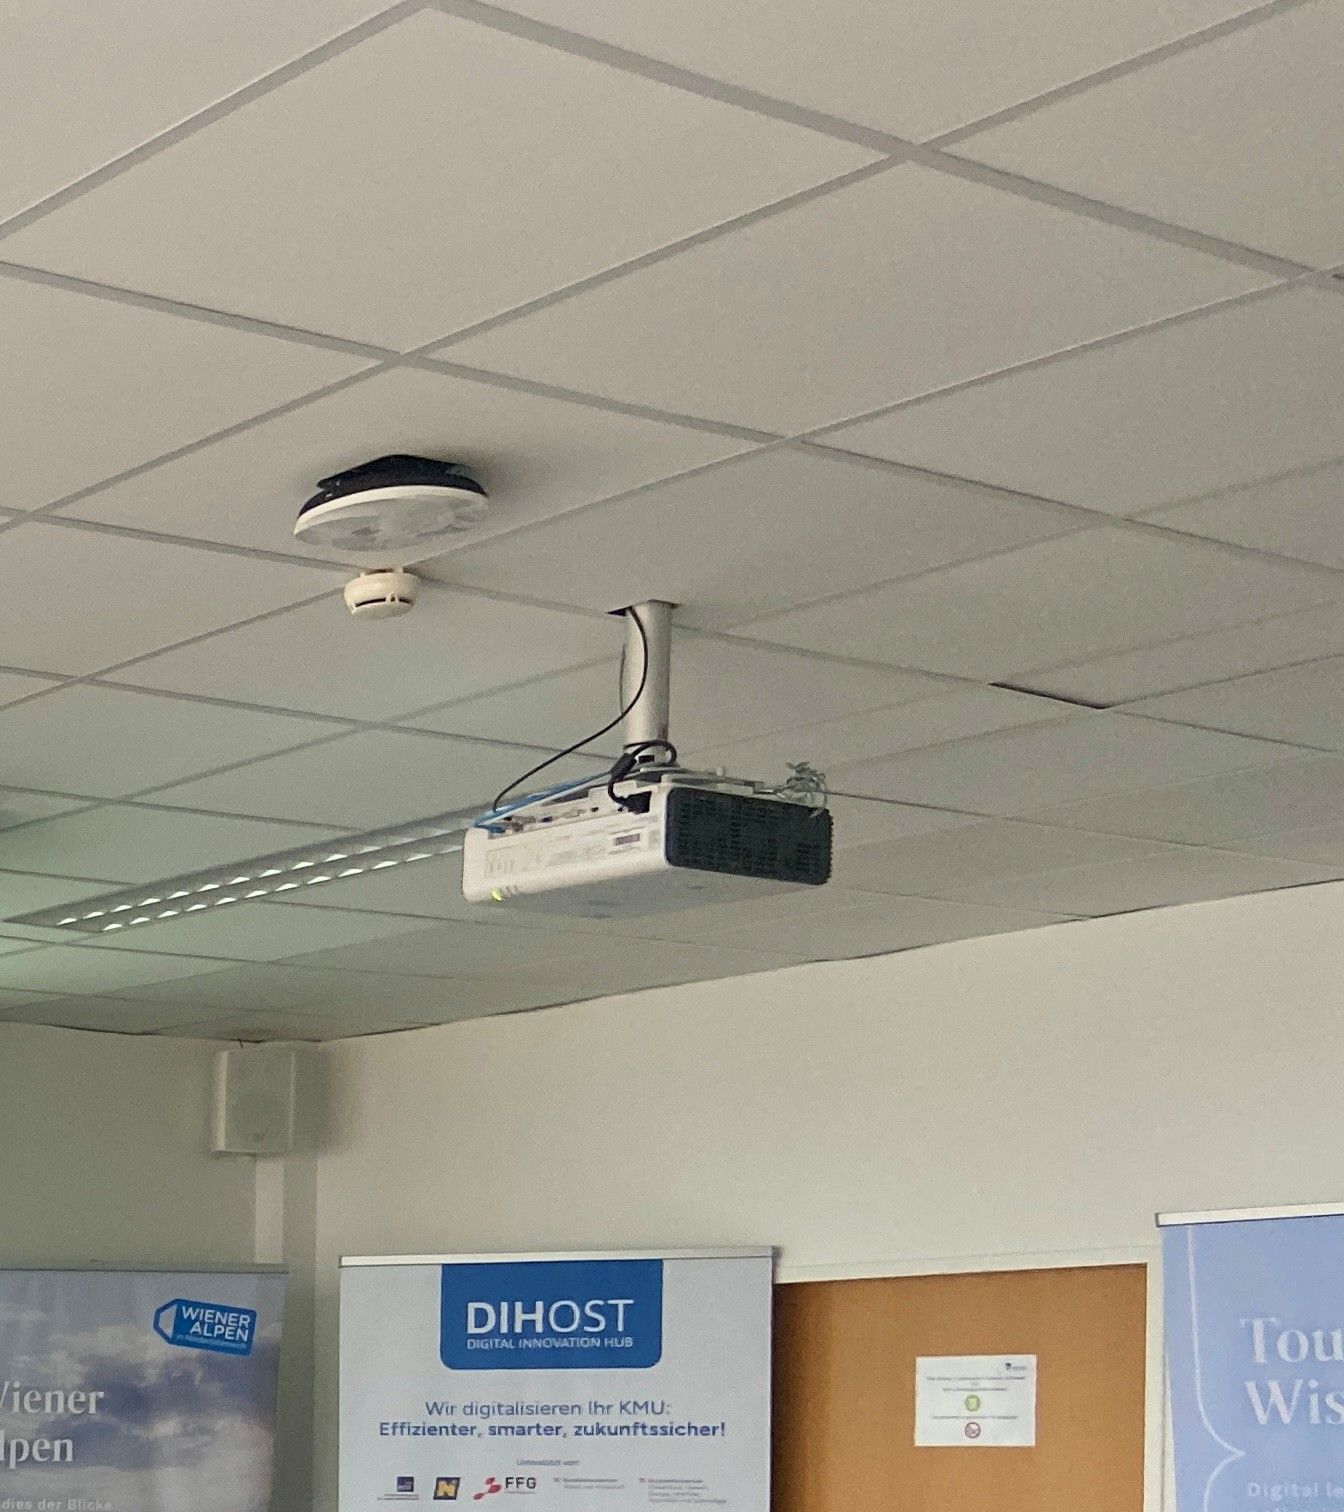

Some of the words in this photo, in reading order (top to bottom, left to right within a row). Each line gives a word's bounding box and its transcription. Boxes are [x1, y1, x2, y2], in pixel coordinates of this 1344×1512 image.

[182, 1305, 251, 1330] WIENER
[466, 1299, 634, 1335] DIHOST
[190, 1321, 249, 1342] ALPEN
[466, 1337, 515, 1350] DIGITAL
[518, 1336, 601, 1349] INNOVATION
[604, 1336, 633, 1348] HUB
[425, 1401, 457, 1416] Wir
[462, 1401, 582, 1419] digitalisieren
[587, 1400, 613, 1416] Ihr
[618, 1400, 671, 1416] KMU:
[378, 1421, 482, 1438] Effizienter,
[488, 1422, 568, 1438] smarter,
[573, 1421, 726, 1437] zukunftssicher!
[505, 1476, 537, 1490] FFG
[37, 1499, 62, 1511] der
[67, 1499, 112, 1511] Blicke
